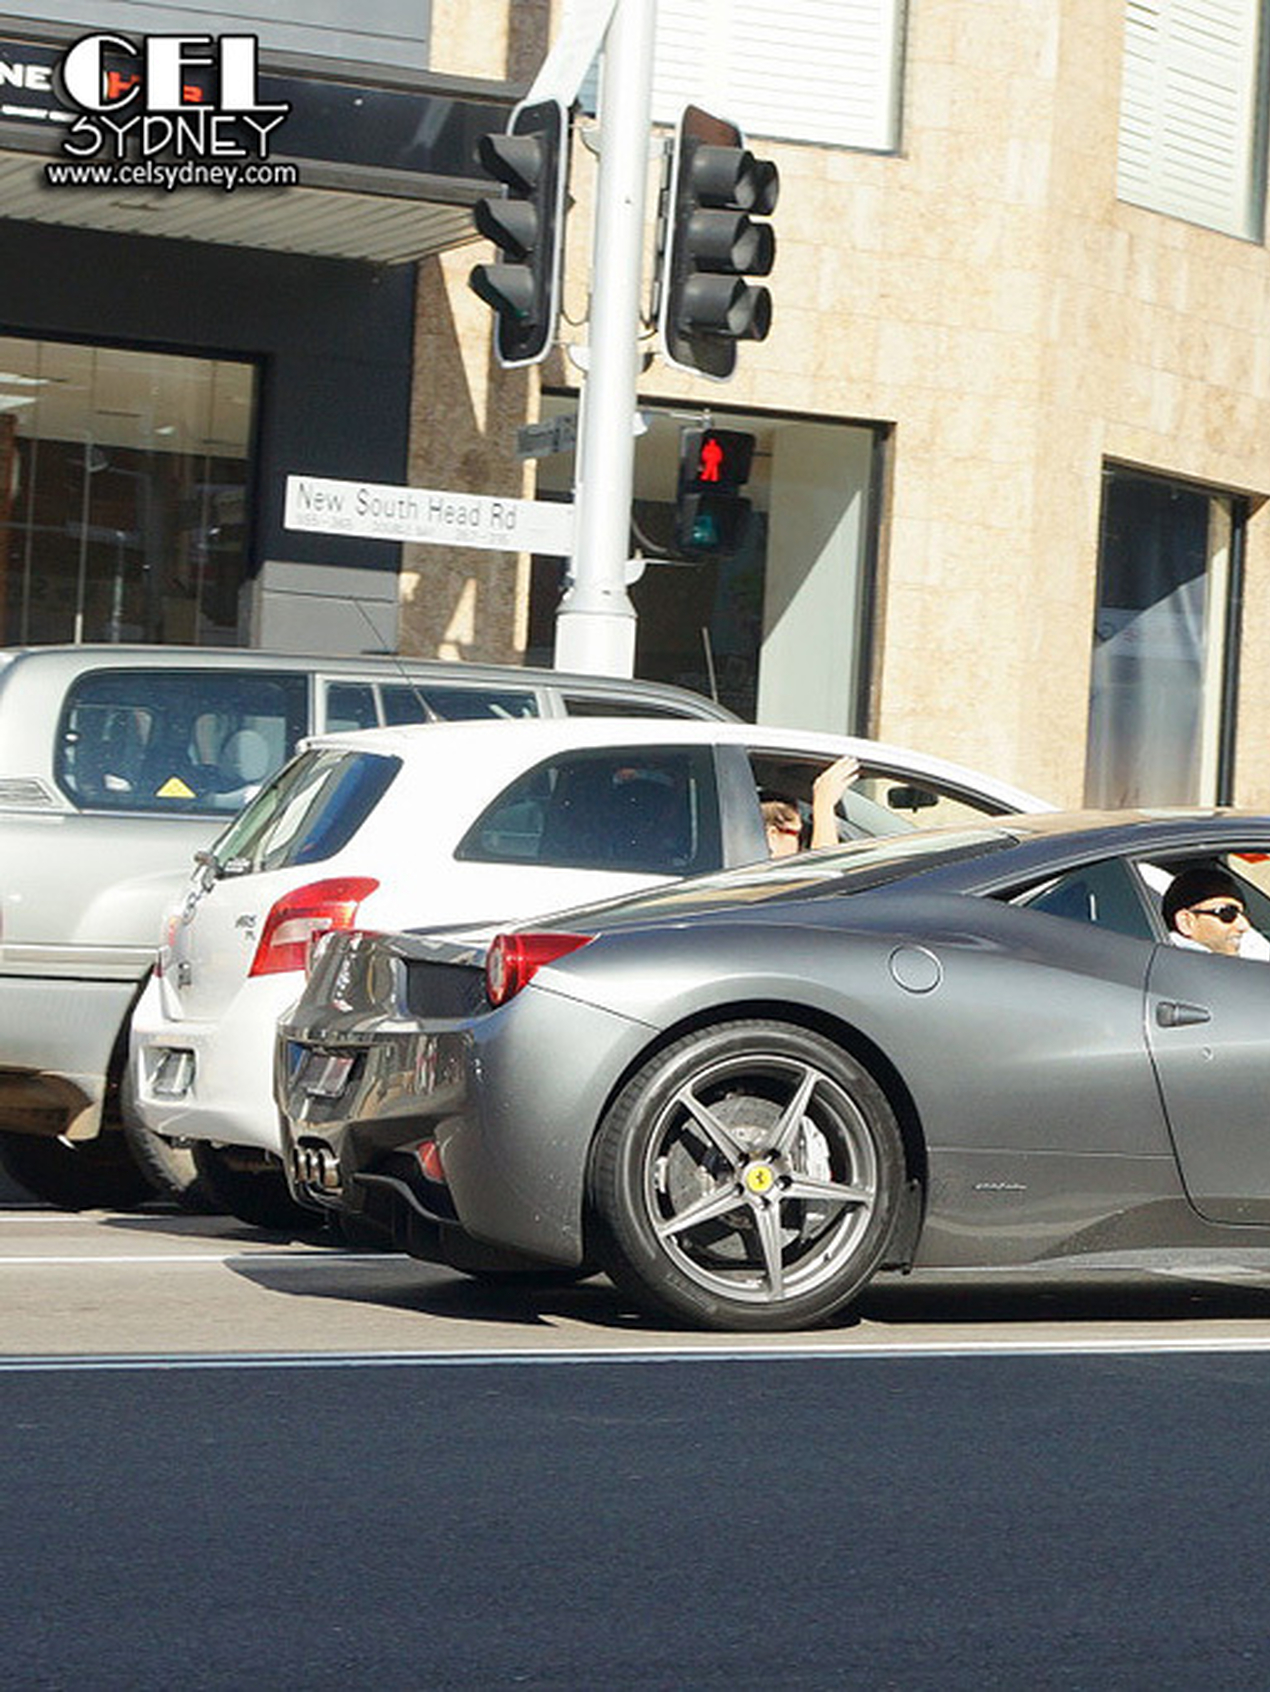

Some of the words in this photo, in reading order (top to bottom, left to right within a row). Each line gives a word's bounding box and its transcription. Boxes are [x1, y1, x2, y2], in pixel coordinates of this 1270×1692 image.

[299, 482, 344, 513] New
[355, 488, 419, 520] South
[428, 496, 481, 528] Head
[489, 502, 518, 531] Rd
